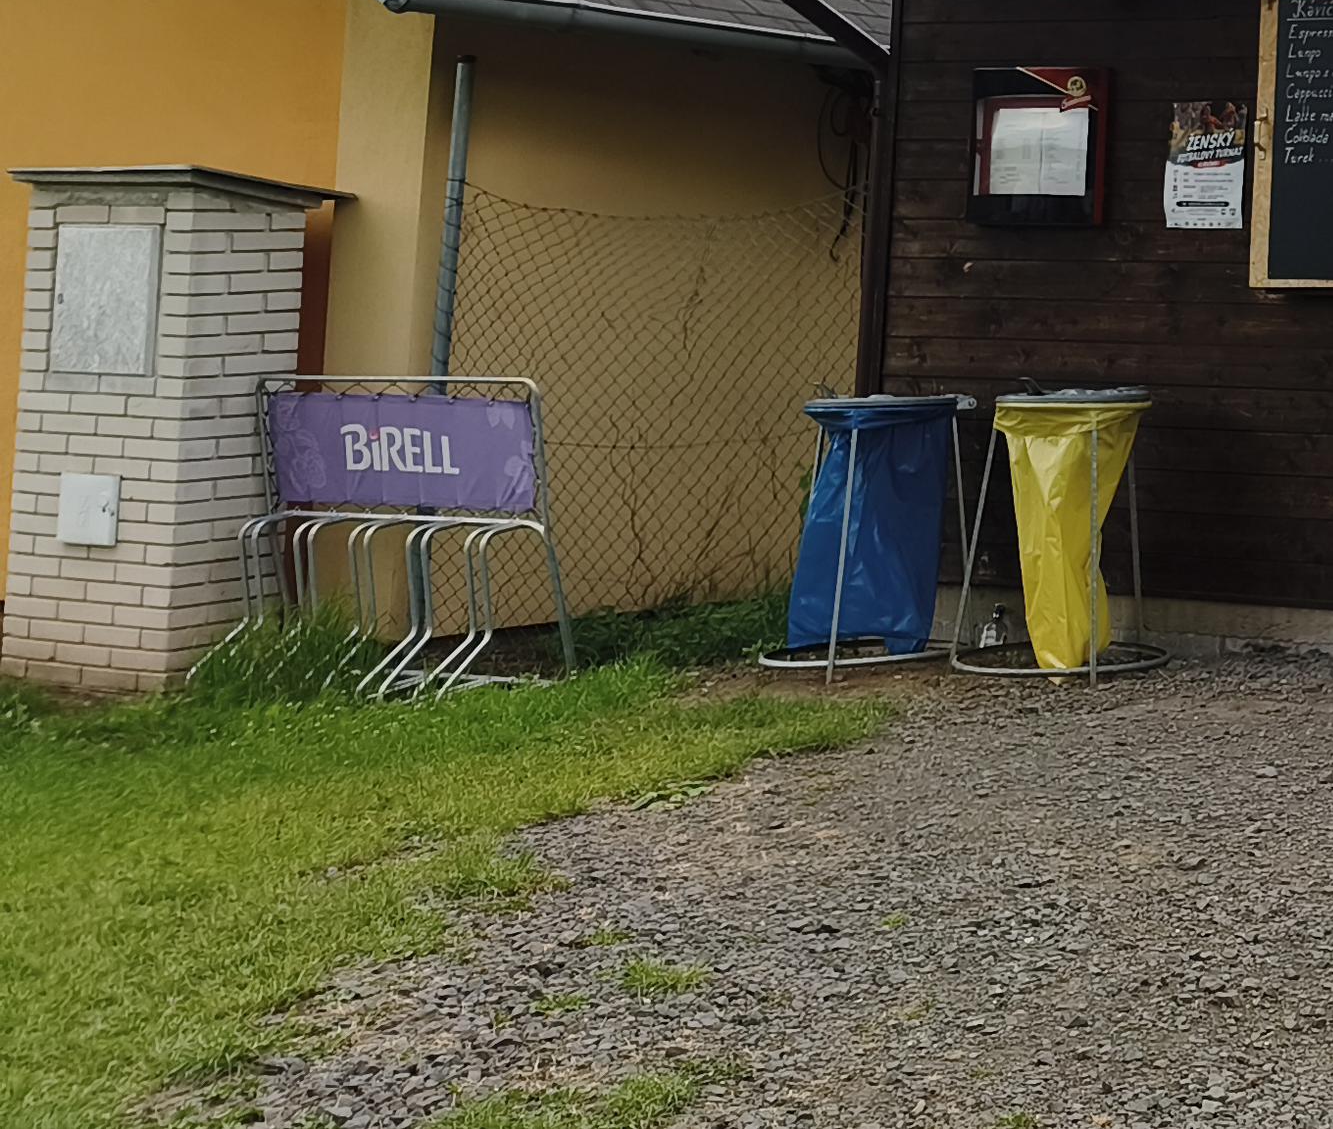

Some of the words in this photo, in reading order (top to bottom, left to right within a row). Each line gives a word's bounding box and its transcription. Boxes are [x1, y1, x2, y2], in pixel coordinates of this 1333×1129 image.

[1287, 43, 1322, 64] Lungo
[1285, 105, 1316, 123] Latte
[1186, 128, 1235, 152] ŽENSKÝ
[1284, 146, 1315, 164] Turek
